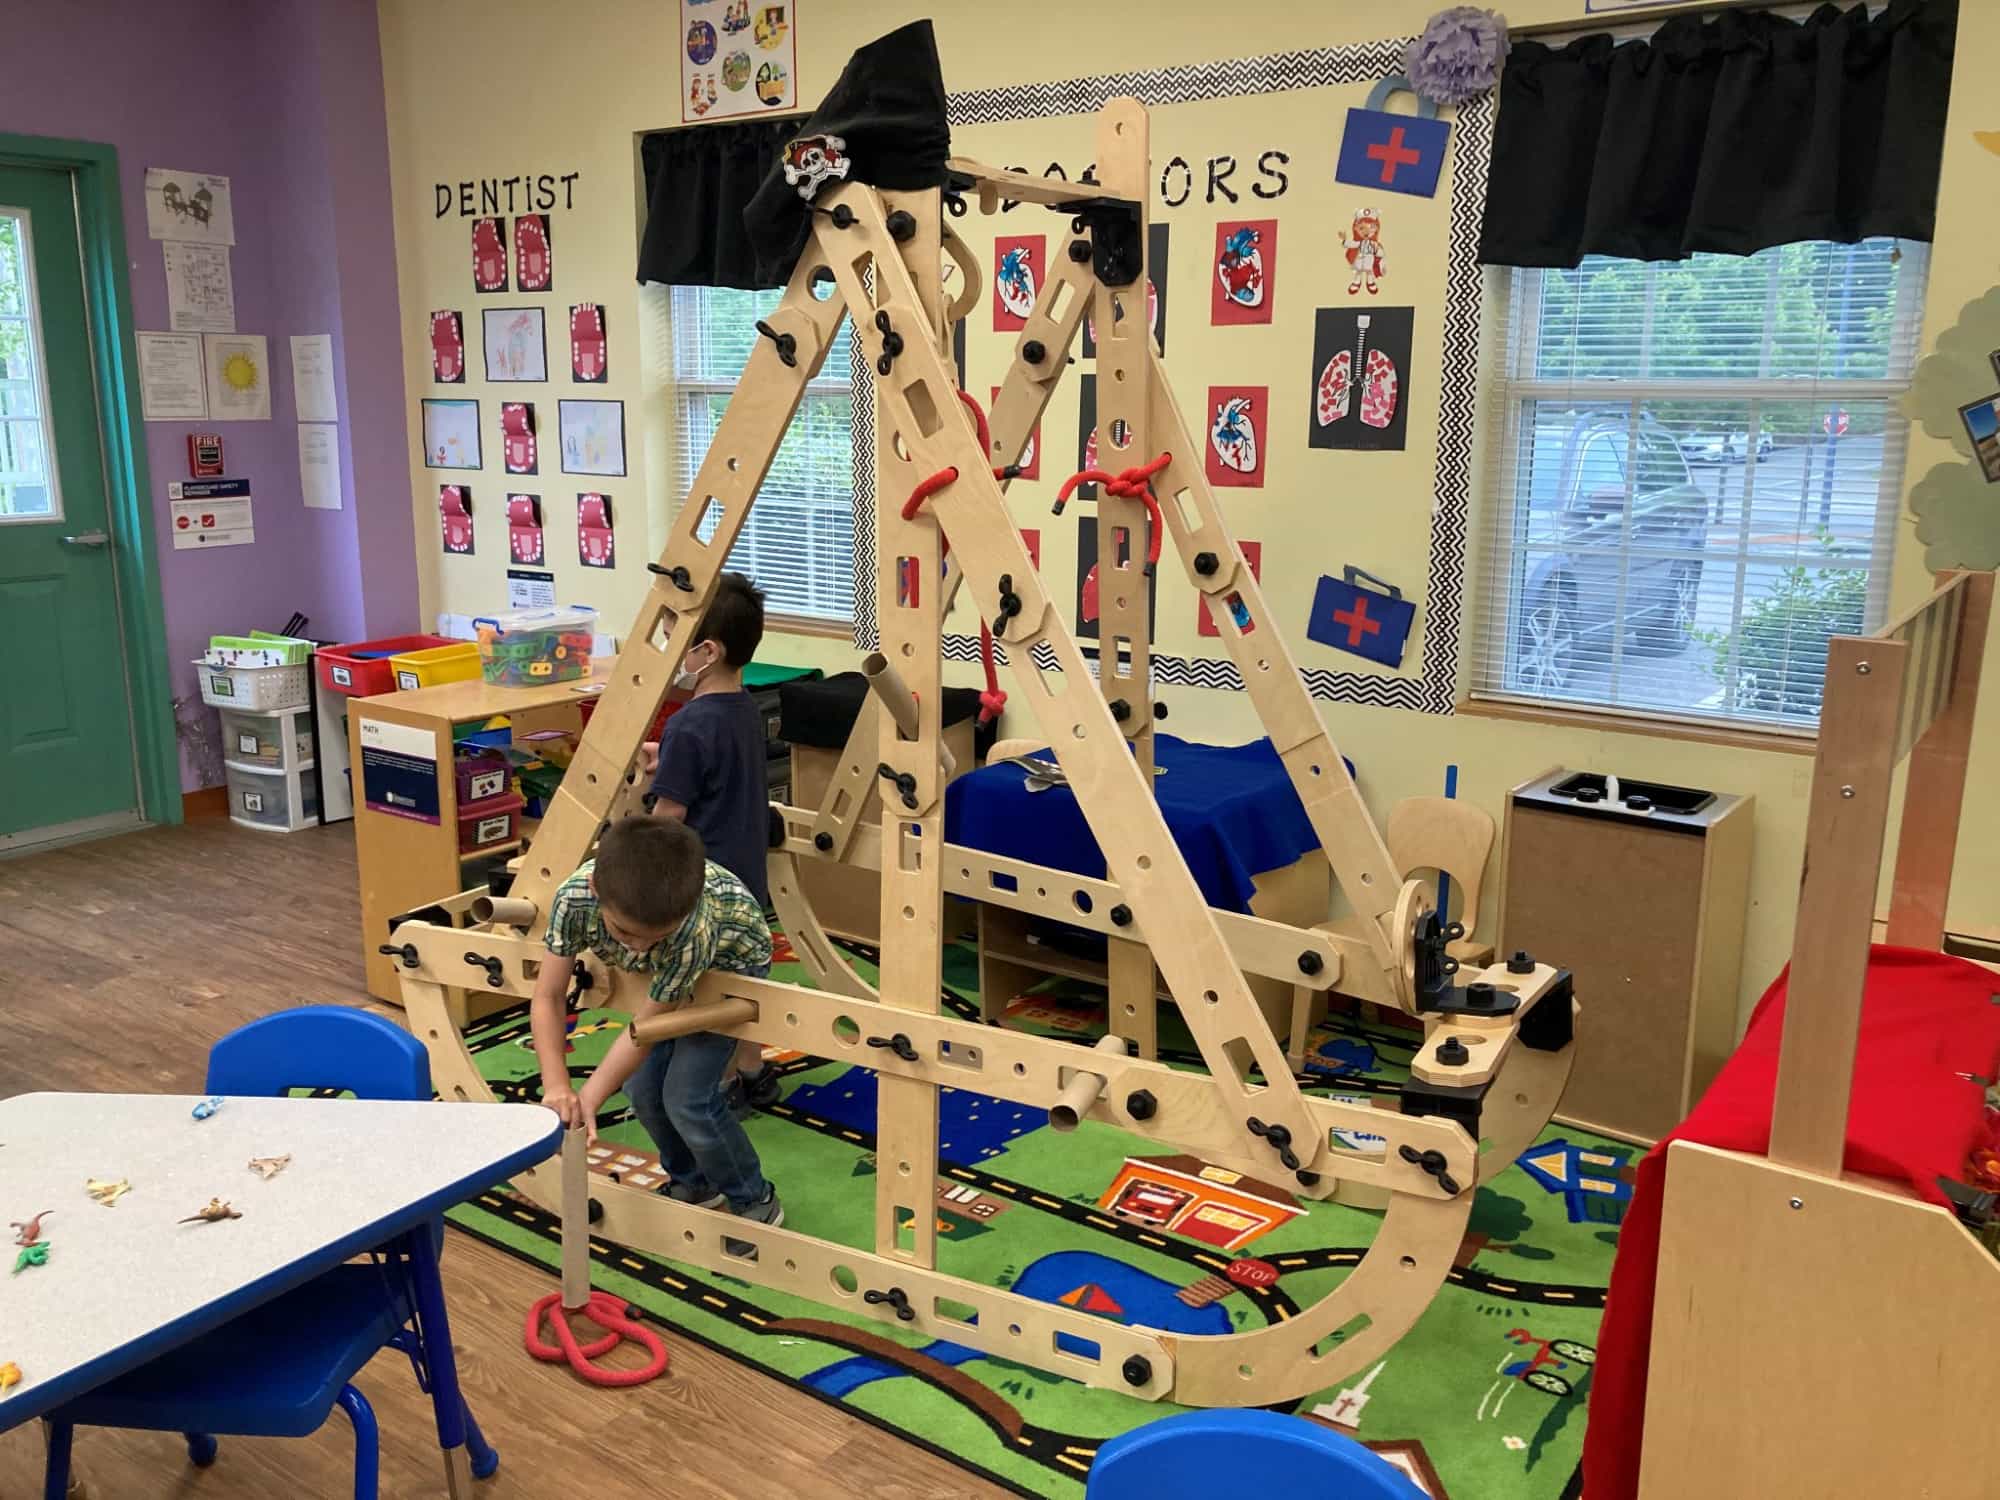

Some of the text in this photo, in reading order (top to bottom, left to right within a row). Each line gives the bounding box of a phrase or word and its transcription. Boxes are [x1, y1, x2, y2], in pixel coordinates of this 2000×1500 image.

[196, 437, 219, 446] FIRE
[363, 725, 379, 734] MATH
[1229, 1262, 1276, 1281] STOP
